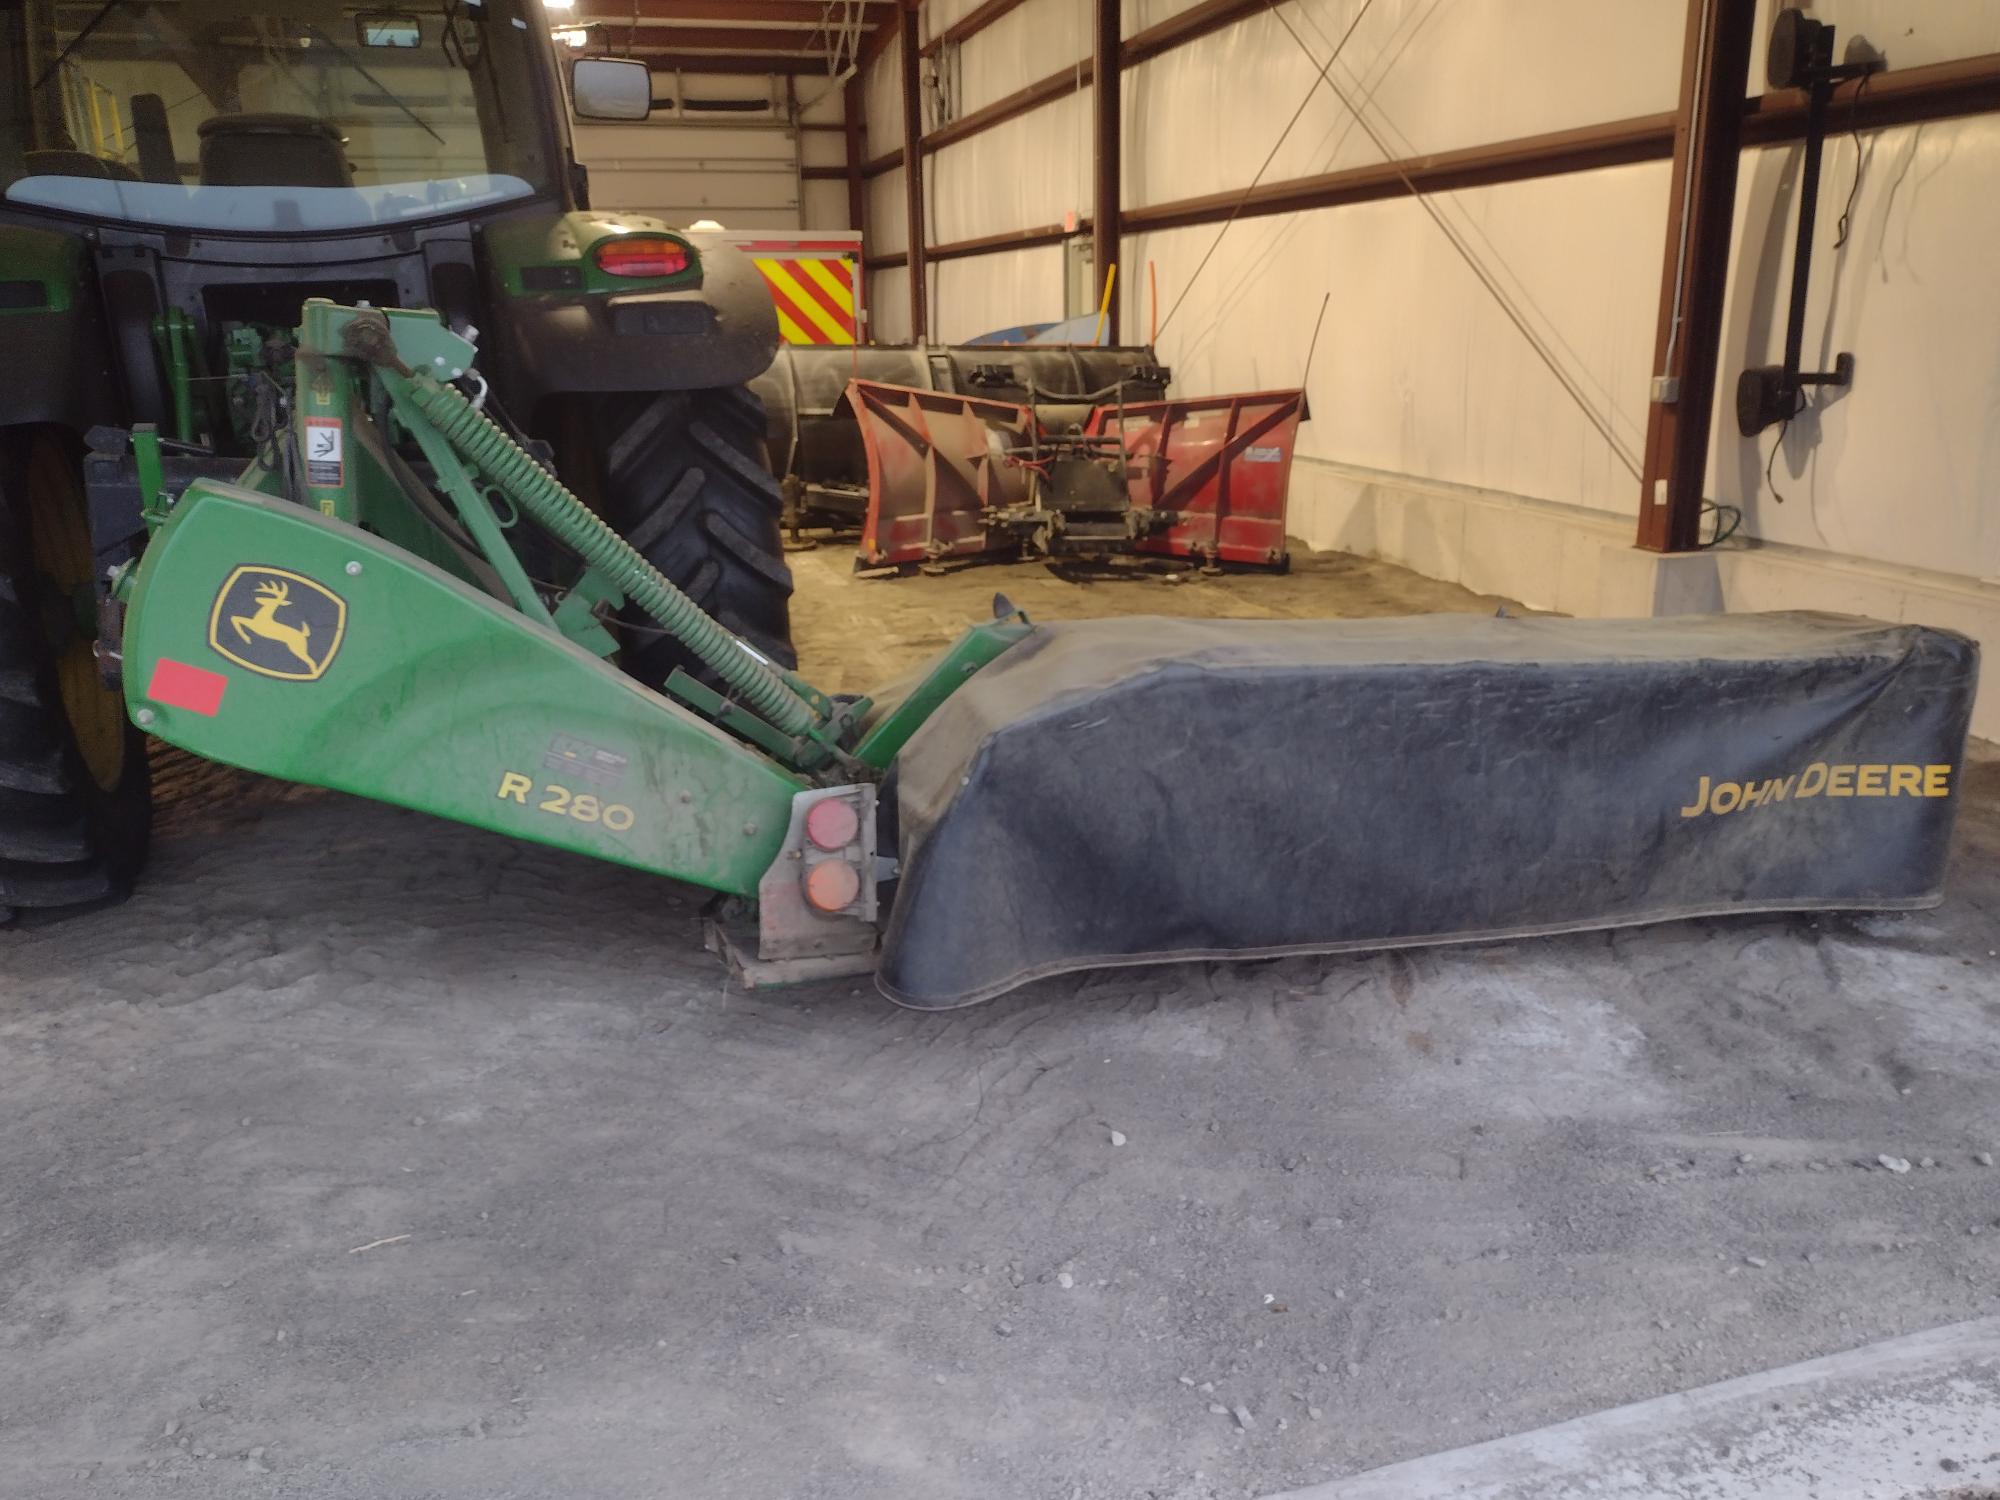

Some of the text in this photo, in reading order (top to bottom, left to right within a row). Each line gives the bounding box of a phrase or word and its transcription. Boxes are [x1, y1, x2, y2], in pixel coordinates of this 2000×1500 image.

[497, 771, 635, 831] R 280
[1680, 761, 1952, 818] JOHN DEERE
